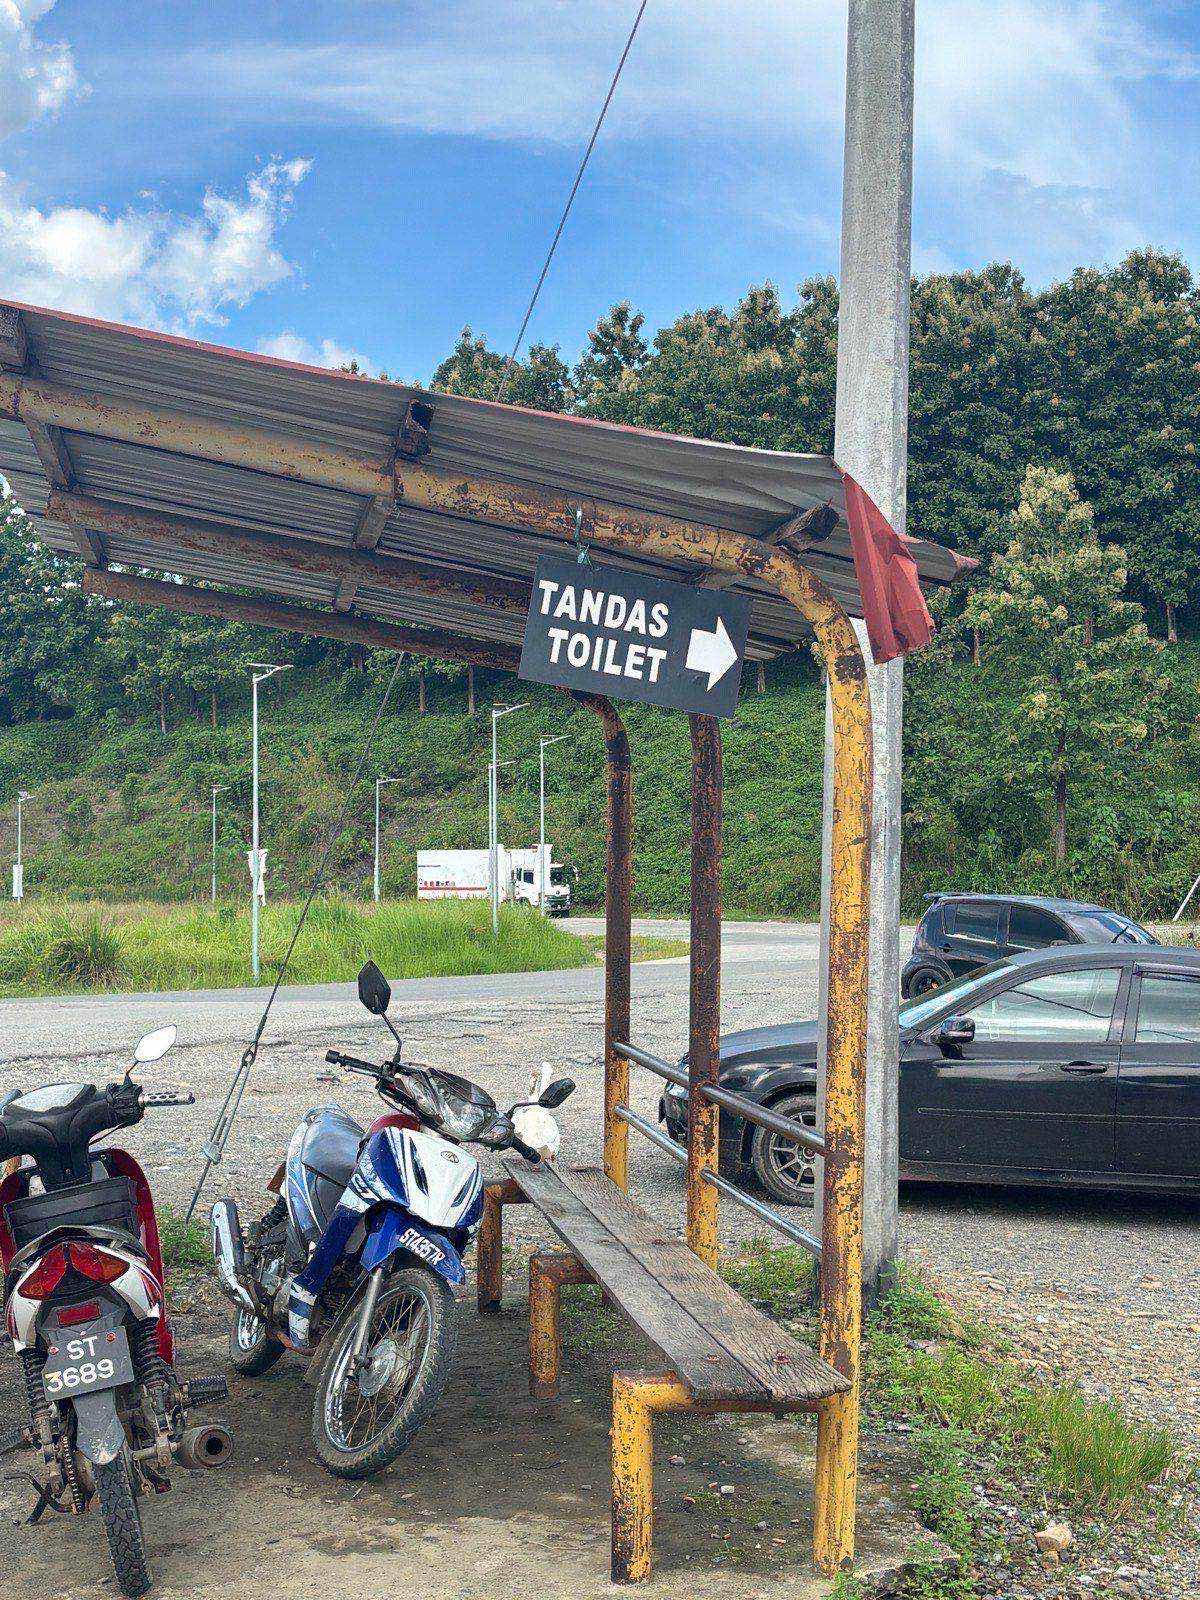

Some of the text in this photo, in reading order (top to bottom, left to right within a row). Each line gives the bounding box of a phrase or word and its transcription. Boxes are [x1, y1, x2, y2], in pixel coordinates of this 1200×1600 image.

[539, 580, 669, 638] TANDAS
[548, 627, 667, 683] TOILET
[66, 1336, 98, 1360] ST
[44, 1358, 115, 1392] 3689
